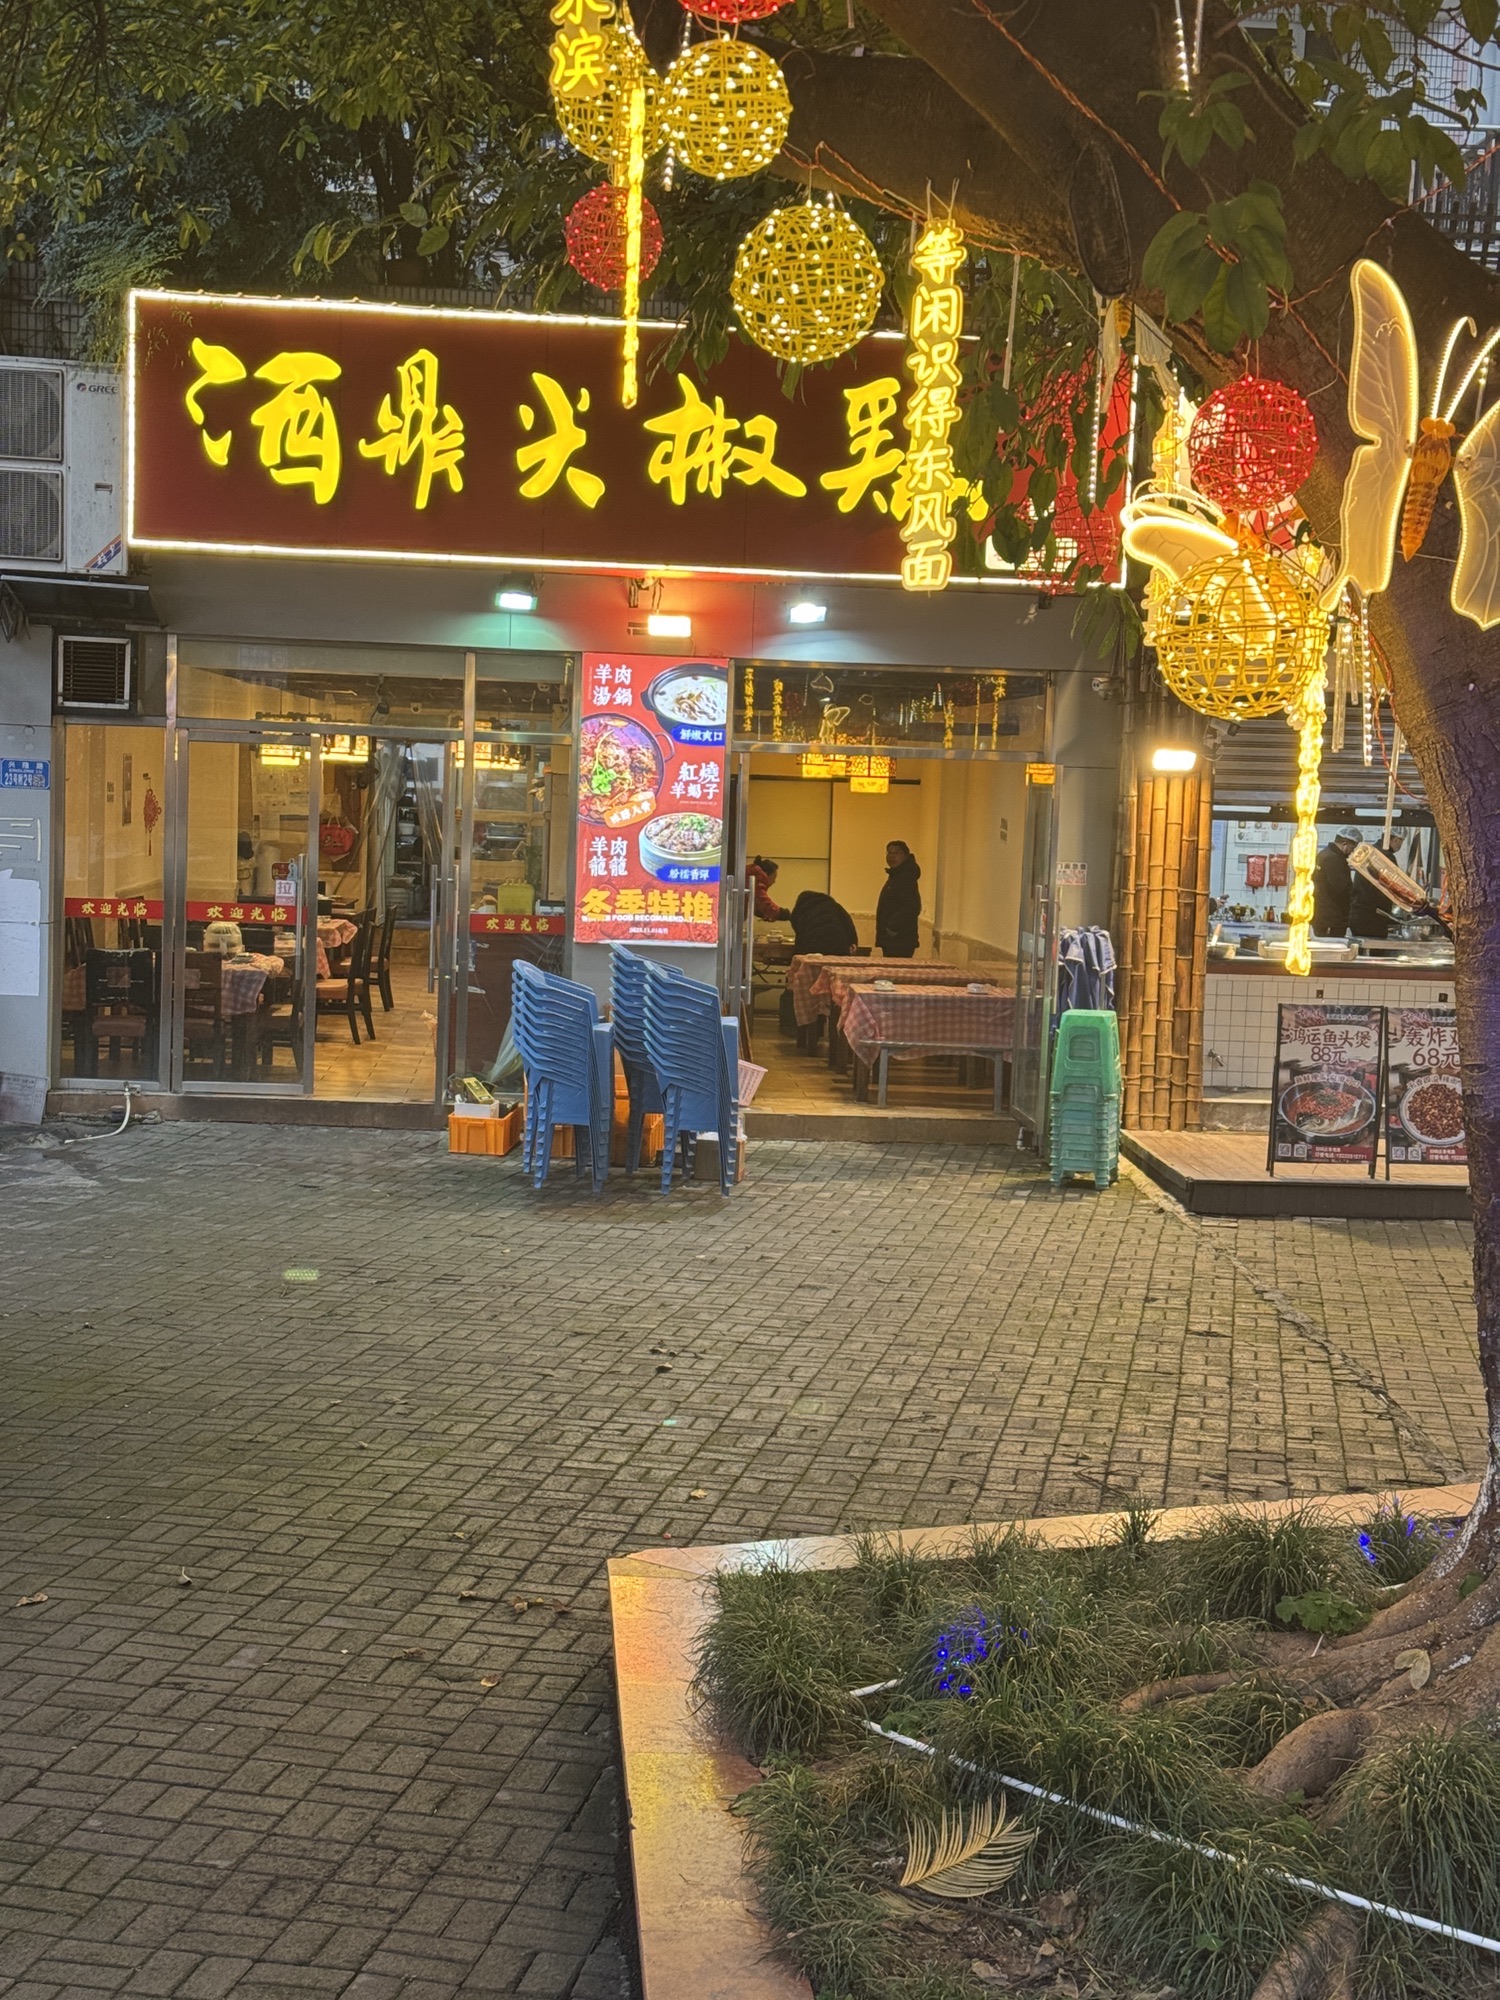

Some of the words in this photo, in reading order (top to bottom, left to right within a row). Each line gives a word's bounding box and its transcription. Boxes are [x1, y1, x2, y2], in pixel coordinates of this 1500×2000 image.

[88, 383, 118, 395] GREE
[903, 221, 966, 590] 等闲识得东风面
[593, 663, 632, 685] 羊肉
[592, 685, 633, 707] 湯鍋
[8, 761, 43, 769] 兴隆路
[677, 761, 720, 784] 紅燒
[589, 836, 628, 857] 羊肉
[278, 881, 292, 894] 拉
[81, 902, 147, 917] 欢迎光临
[207, 906, 287, 922] 欢迎光临
[581, 888, 714, 922] 冬季特推
[486, 917, 549, 932] 欢迎光临
[612, 914, 633, 922] FOOD
[1289, 1027, 1371, 1048] 鸿运鱼头煲
[1311, 1046, 1347, 1065] 88元
[1412, 1047, 1461, 1068] 68元
